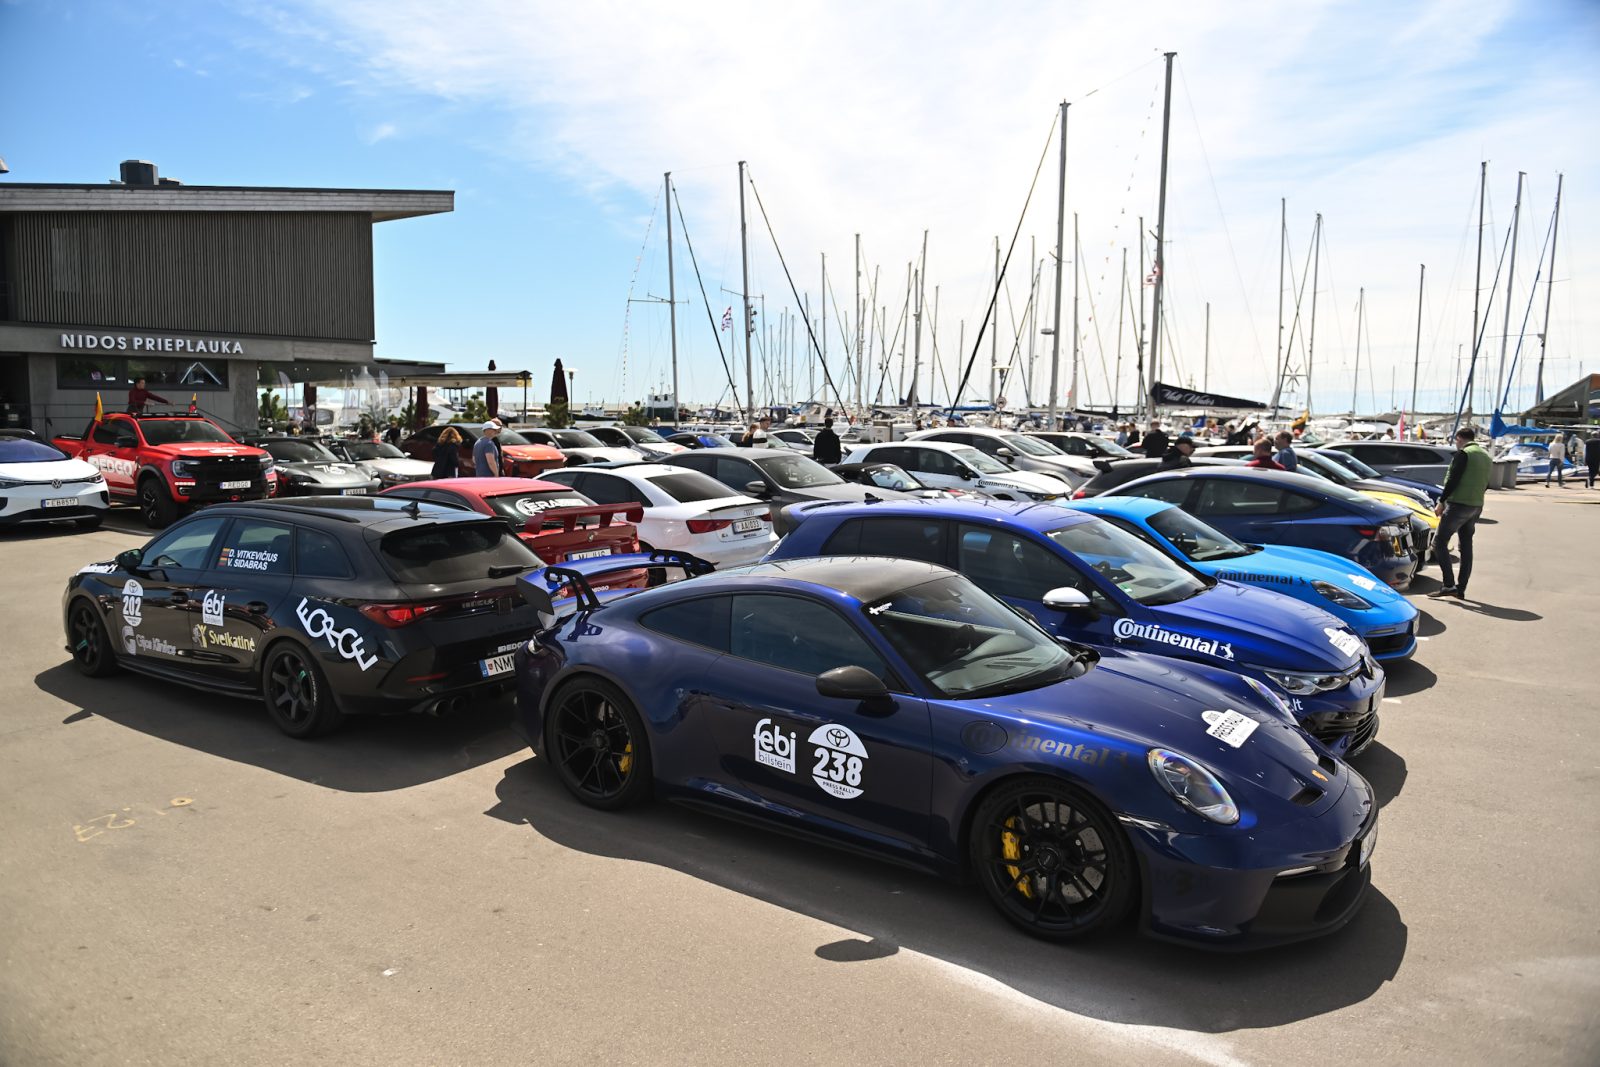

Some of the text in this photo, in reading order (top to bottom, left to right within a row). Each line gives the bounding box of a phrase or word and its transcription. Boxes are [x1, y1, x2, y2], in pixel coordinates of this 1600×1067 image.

[61, 334, 244, 354] NIDOS PRIEPLAUKA
[227, 558, 268, 571] V. SIDABRAS
[228, 549, 279, 562] D. VITKEVIČIUS
[122, 595, 142, 617] 202
[202, 590, 226, 615] febi
[1113, 617, 1219, 656] Continental
[753, 718, 797, 758] febi
[758, 754, 792, 772] bilstein
[812, 747, 863, 787] 238
[822, 781, 839, 791] PRESS
